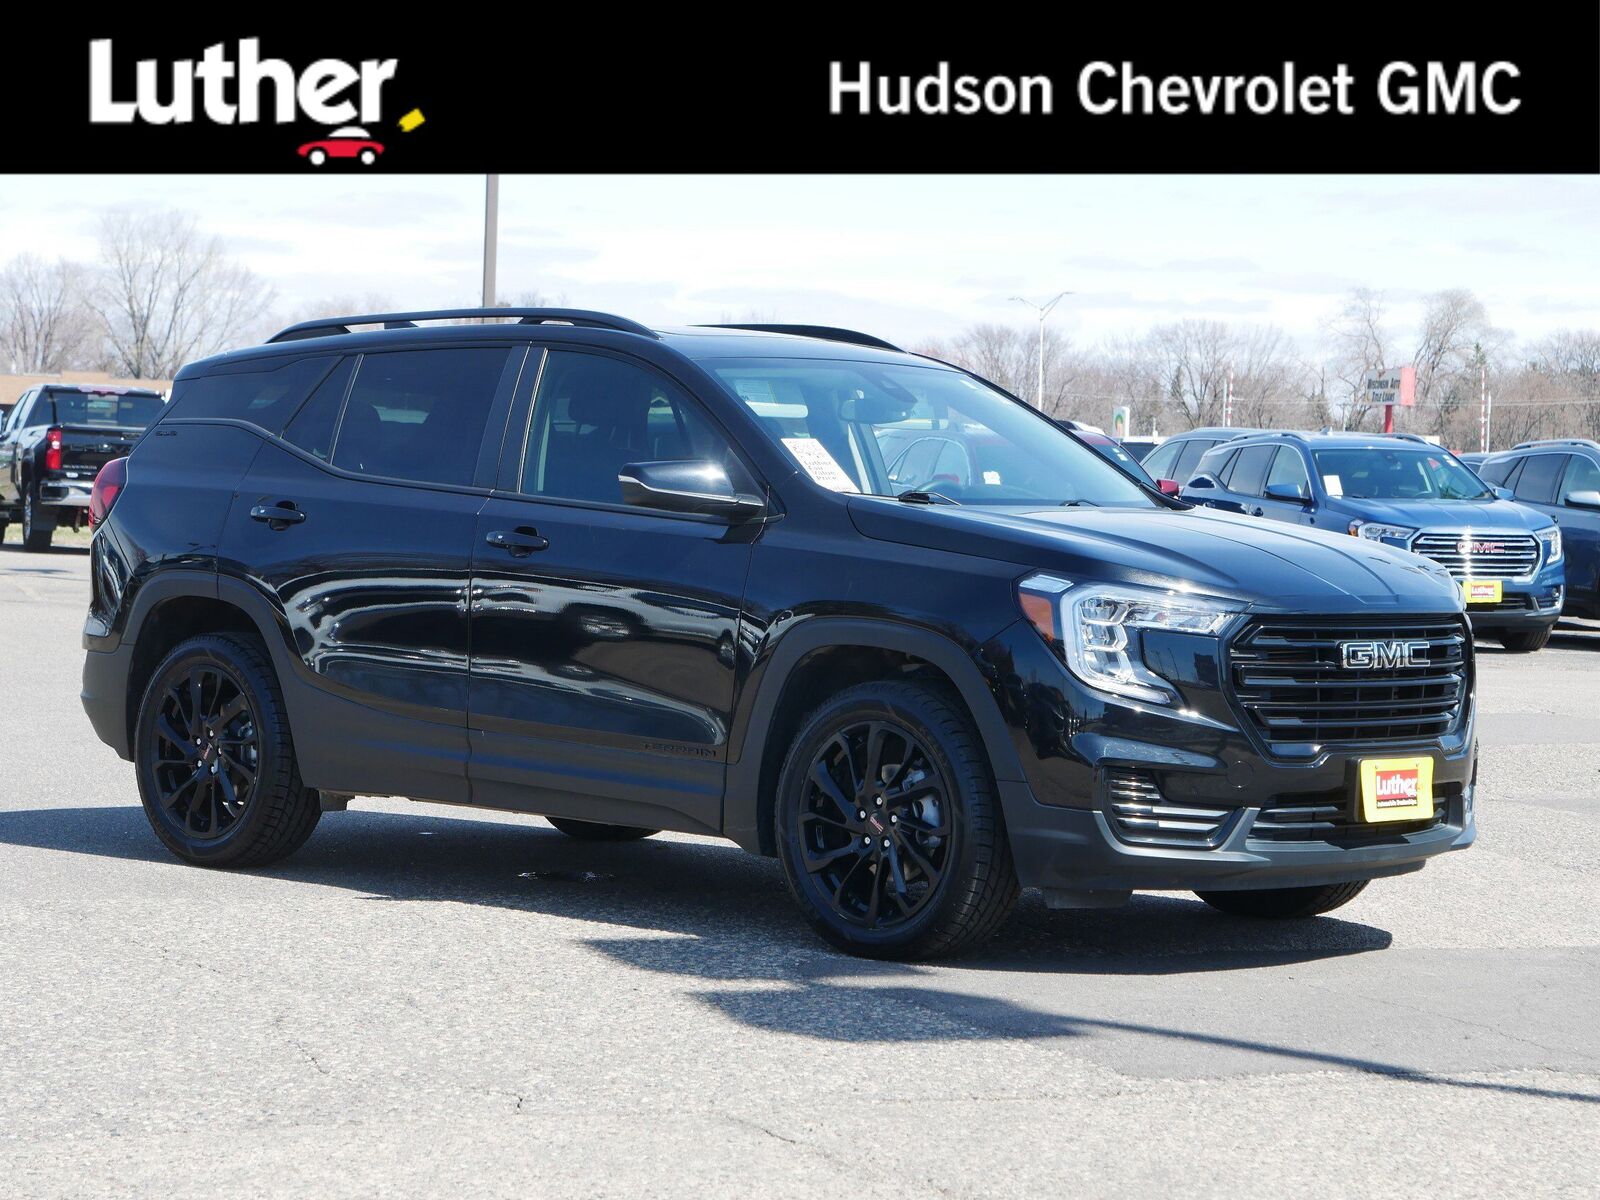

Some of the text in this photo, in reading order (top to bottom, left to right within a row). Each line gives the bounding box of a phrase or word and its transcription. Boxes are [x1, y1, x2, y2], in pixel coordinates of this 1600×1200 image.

[1457, 542, 1505, 554] GMC
[1342, 641, 1431, 669] GMC
[1376, 773, 1418, 795] Luther
